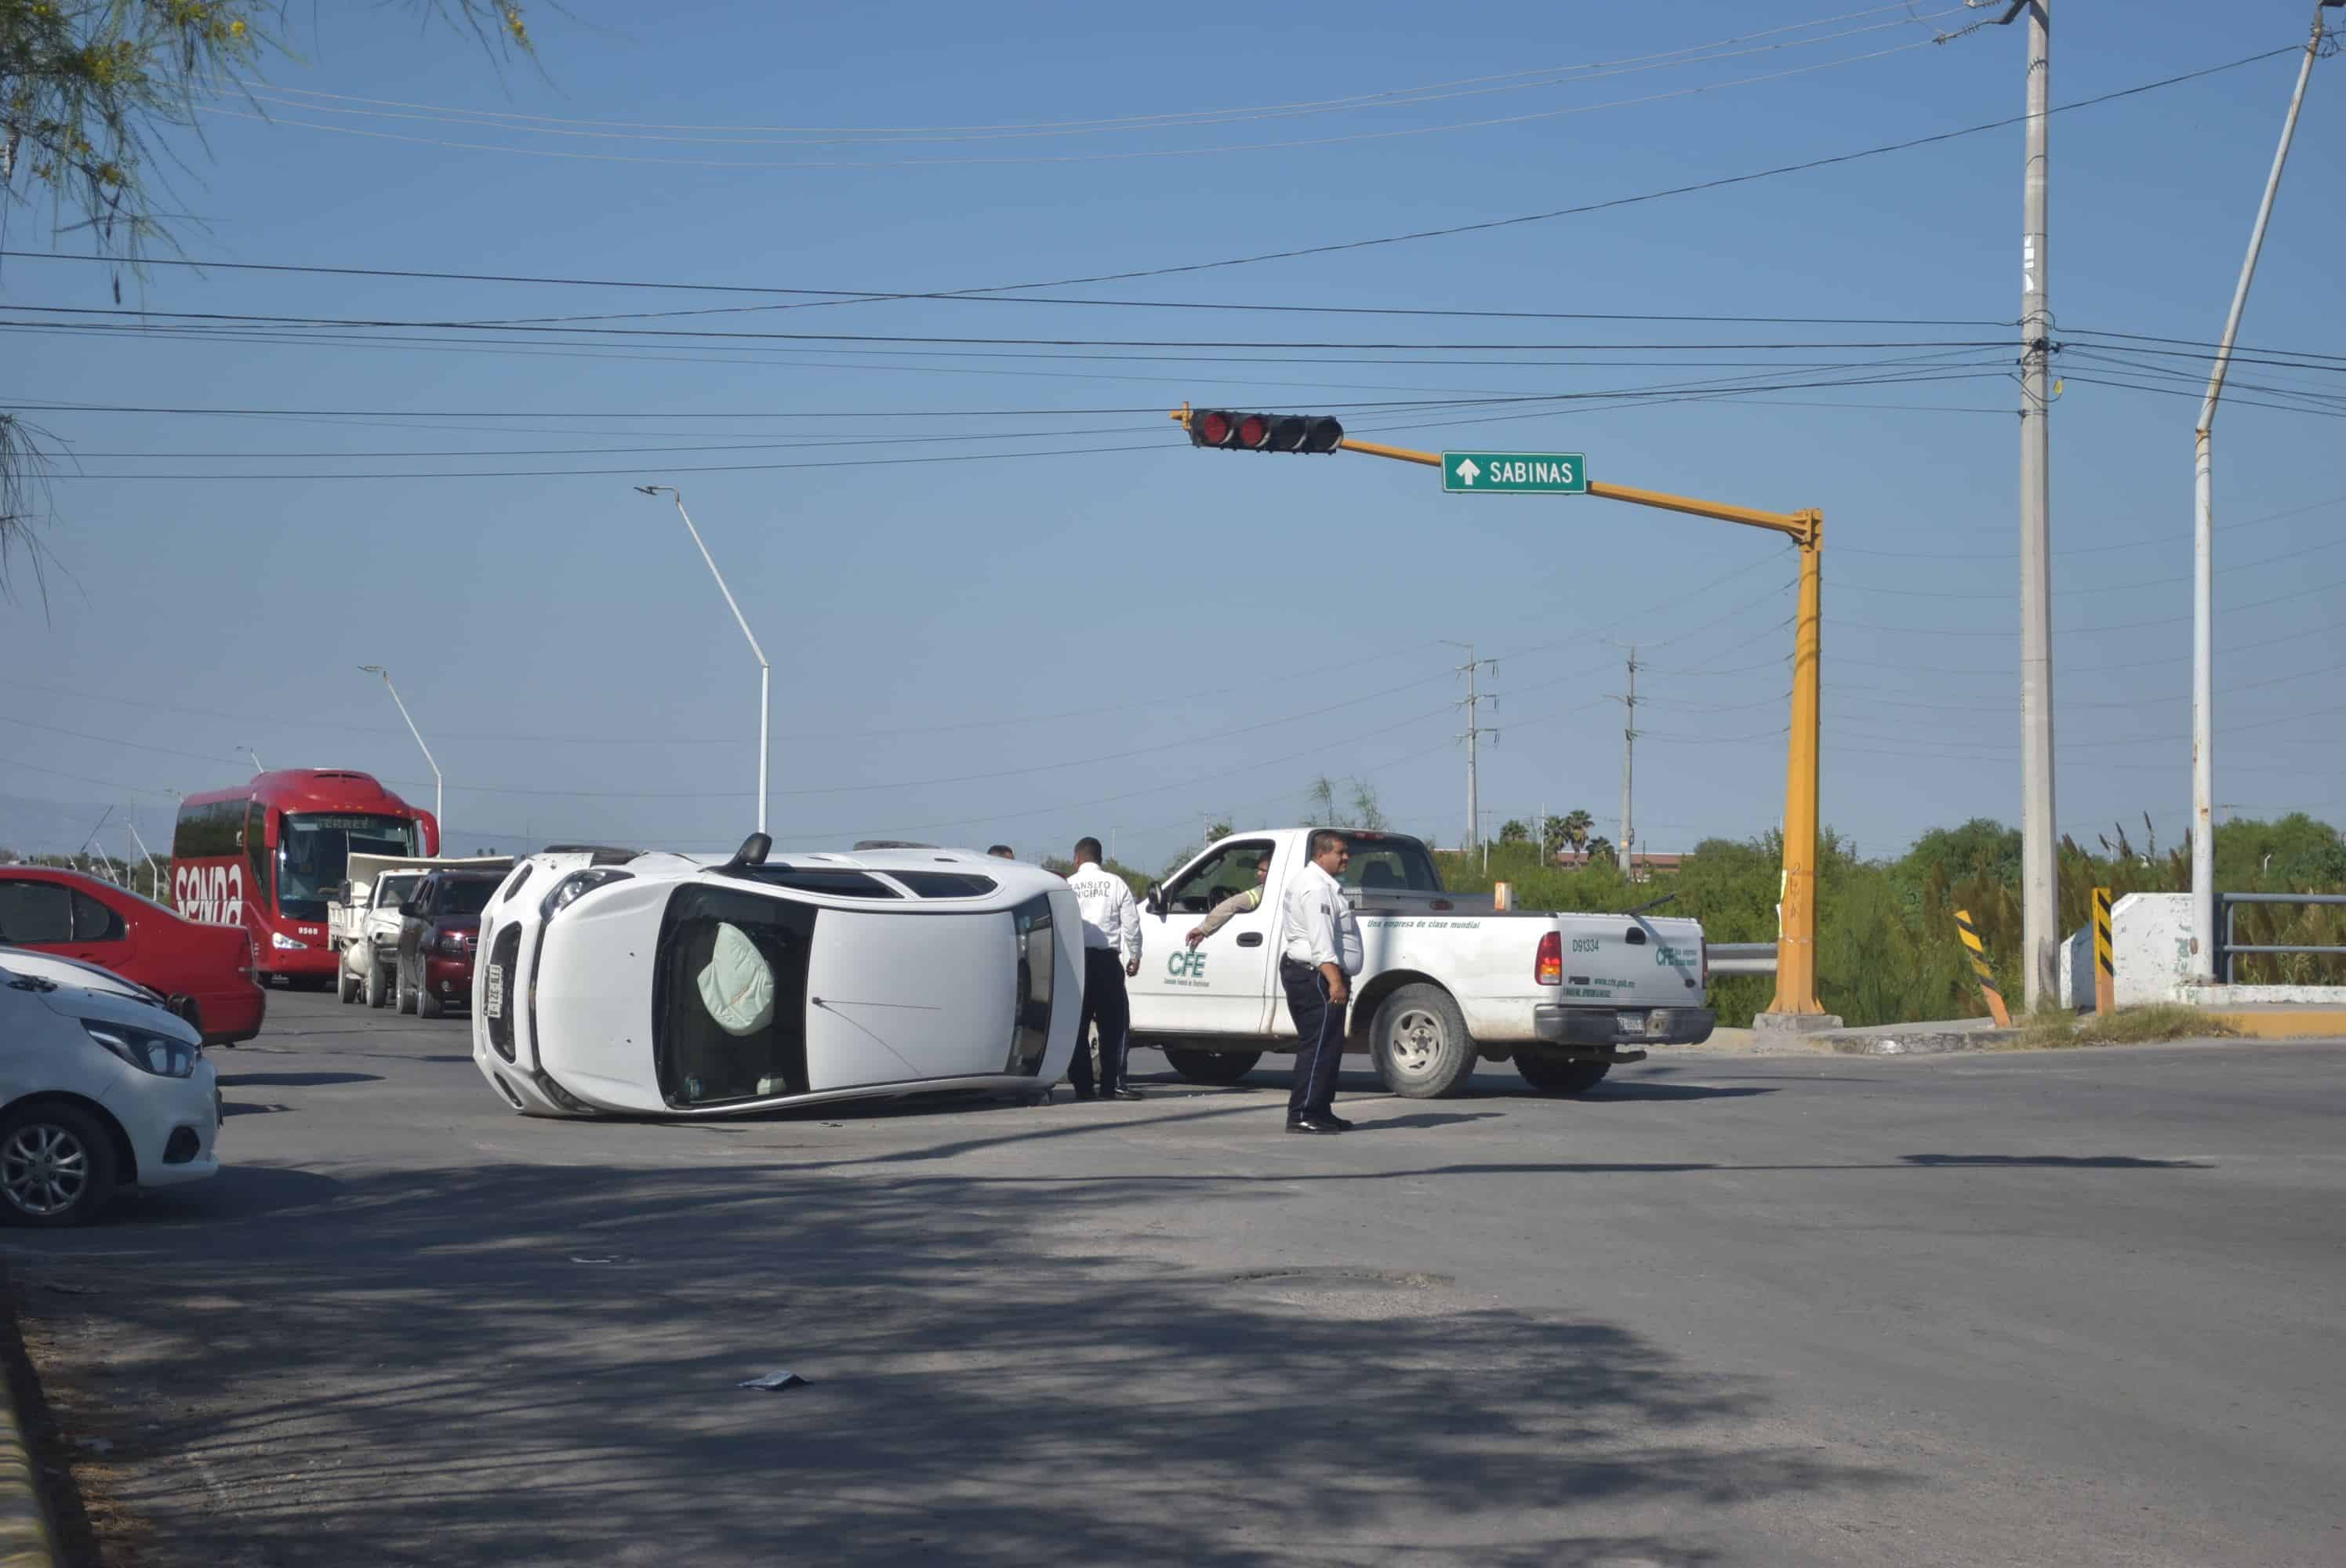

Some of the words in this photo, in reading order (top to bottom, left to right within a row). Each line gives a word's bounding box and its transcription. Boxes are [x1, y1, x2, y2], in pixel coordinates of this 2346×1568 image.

[1491, 461, 1573, 483] SABINAS
[1073, 880, 1111, 890] ANSITO
[1367, 919, 1382, 927] Una
[1416, 920, 1425, 928] de
[1428, 919, 1448, 928] clase
[1572, 939, 1600, 953] D91334
[1168, 951, 1208, 978] CFE
[1655, 947, 1674, 966] CFE
